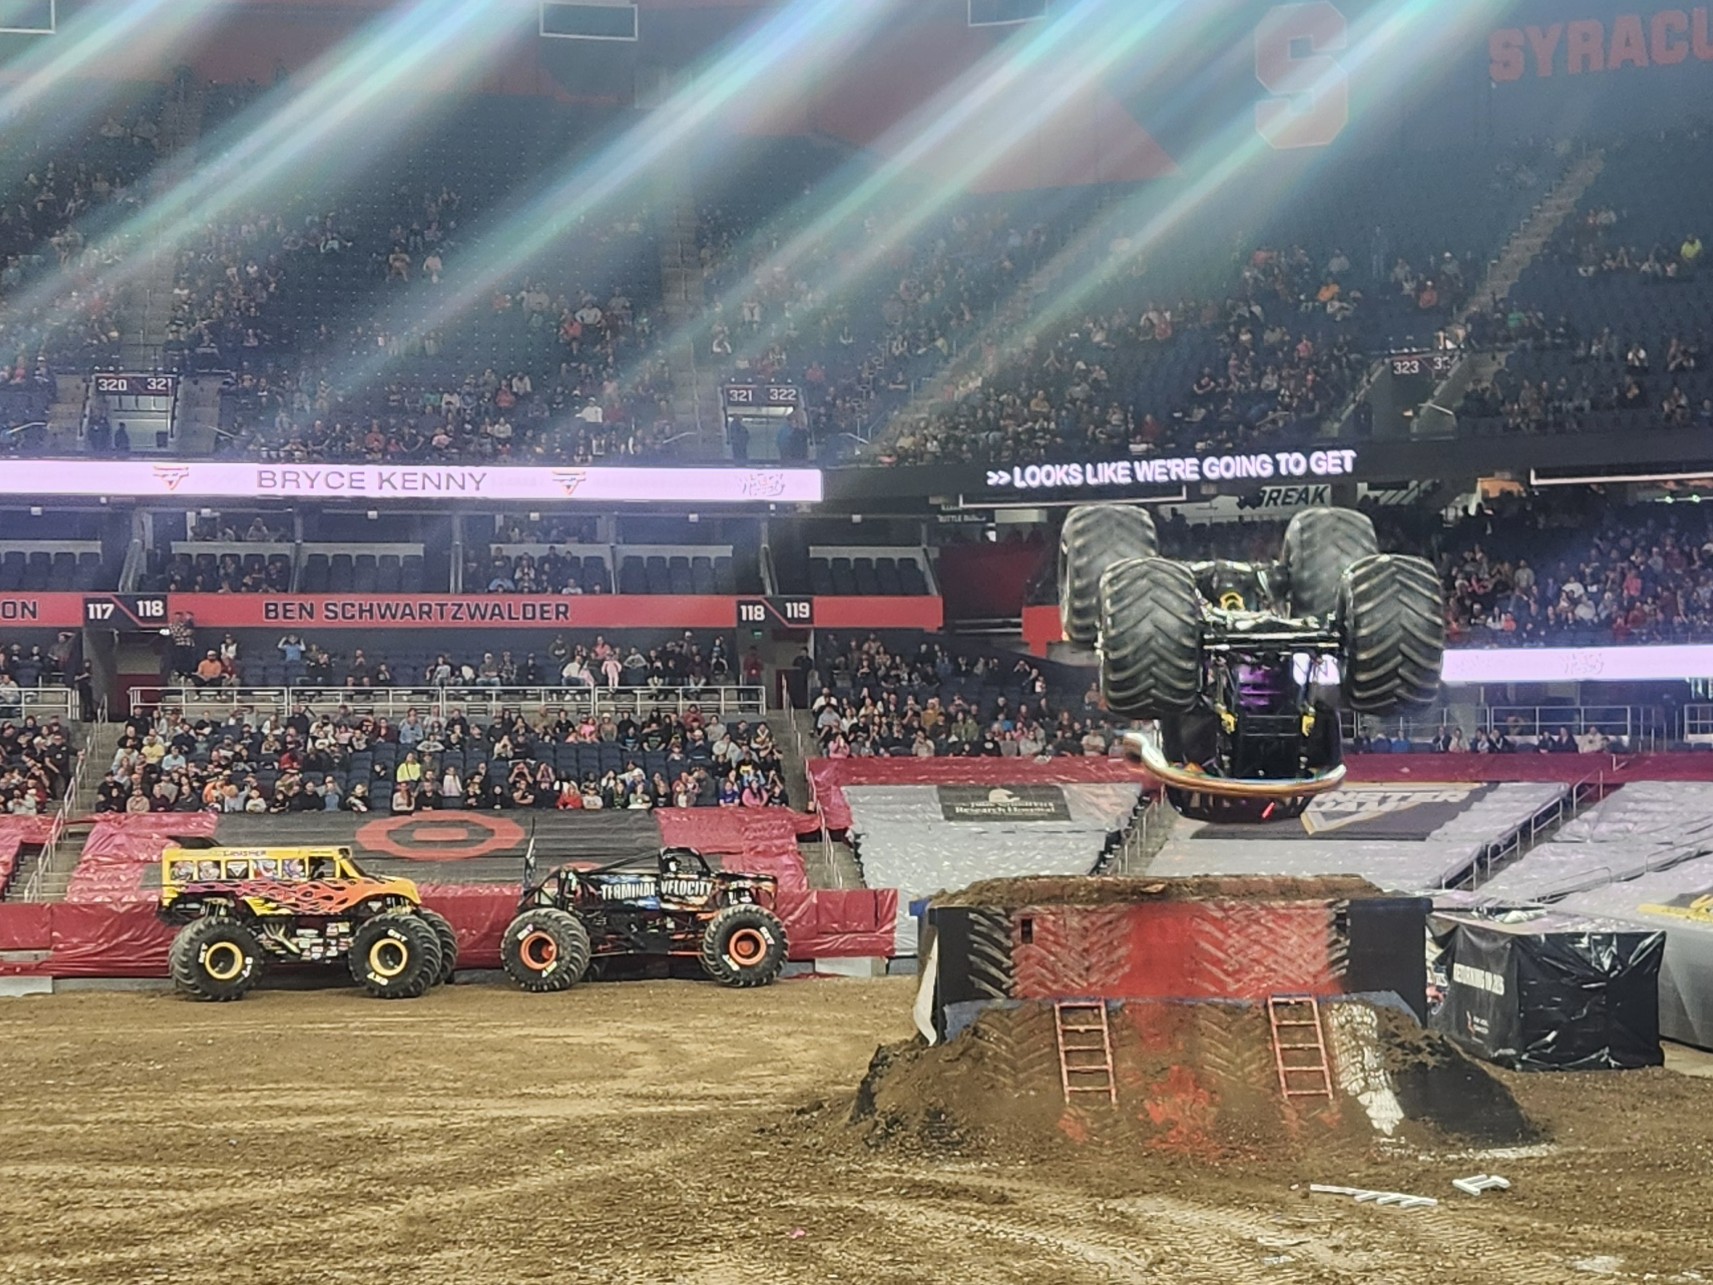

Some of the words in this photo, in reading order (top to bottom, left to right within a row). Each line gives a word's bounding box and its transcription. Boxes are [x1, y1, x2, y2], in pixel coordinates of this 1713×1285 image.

[1393, 360, 1420, 375] 323
[98, 379, 127, 391] 320
[729, 389, 753, 402] 321
[769, 388, 797, 401] 322
[1012, 463, 1084, 489] LOOKS
[1085, 460, 1133, 486] LIKE
[1133, 457, 1201, 483] WE'RE
[1202, 453, 1275, 480] GOING
[1275, 452, 1307, 476] TO
[1309, 449, 1358, 475] GET
[256, 470, 366, 490] BRYCE
[377, 471, 488, 491] KENNY
[87, 603, 115, 620] 117
[136, 600, 165, 617] 118
[264, 602, 315, 620] BEN
[323, 601, 570, 621] SCHWARTZWALDER
[740, 604, 766, 621] 118
[785, 602, 810, 618] 119
[600, 882, 656, 900] TERMINAL
[660, 879, 714, 897] VELOCITY
